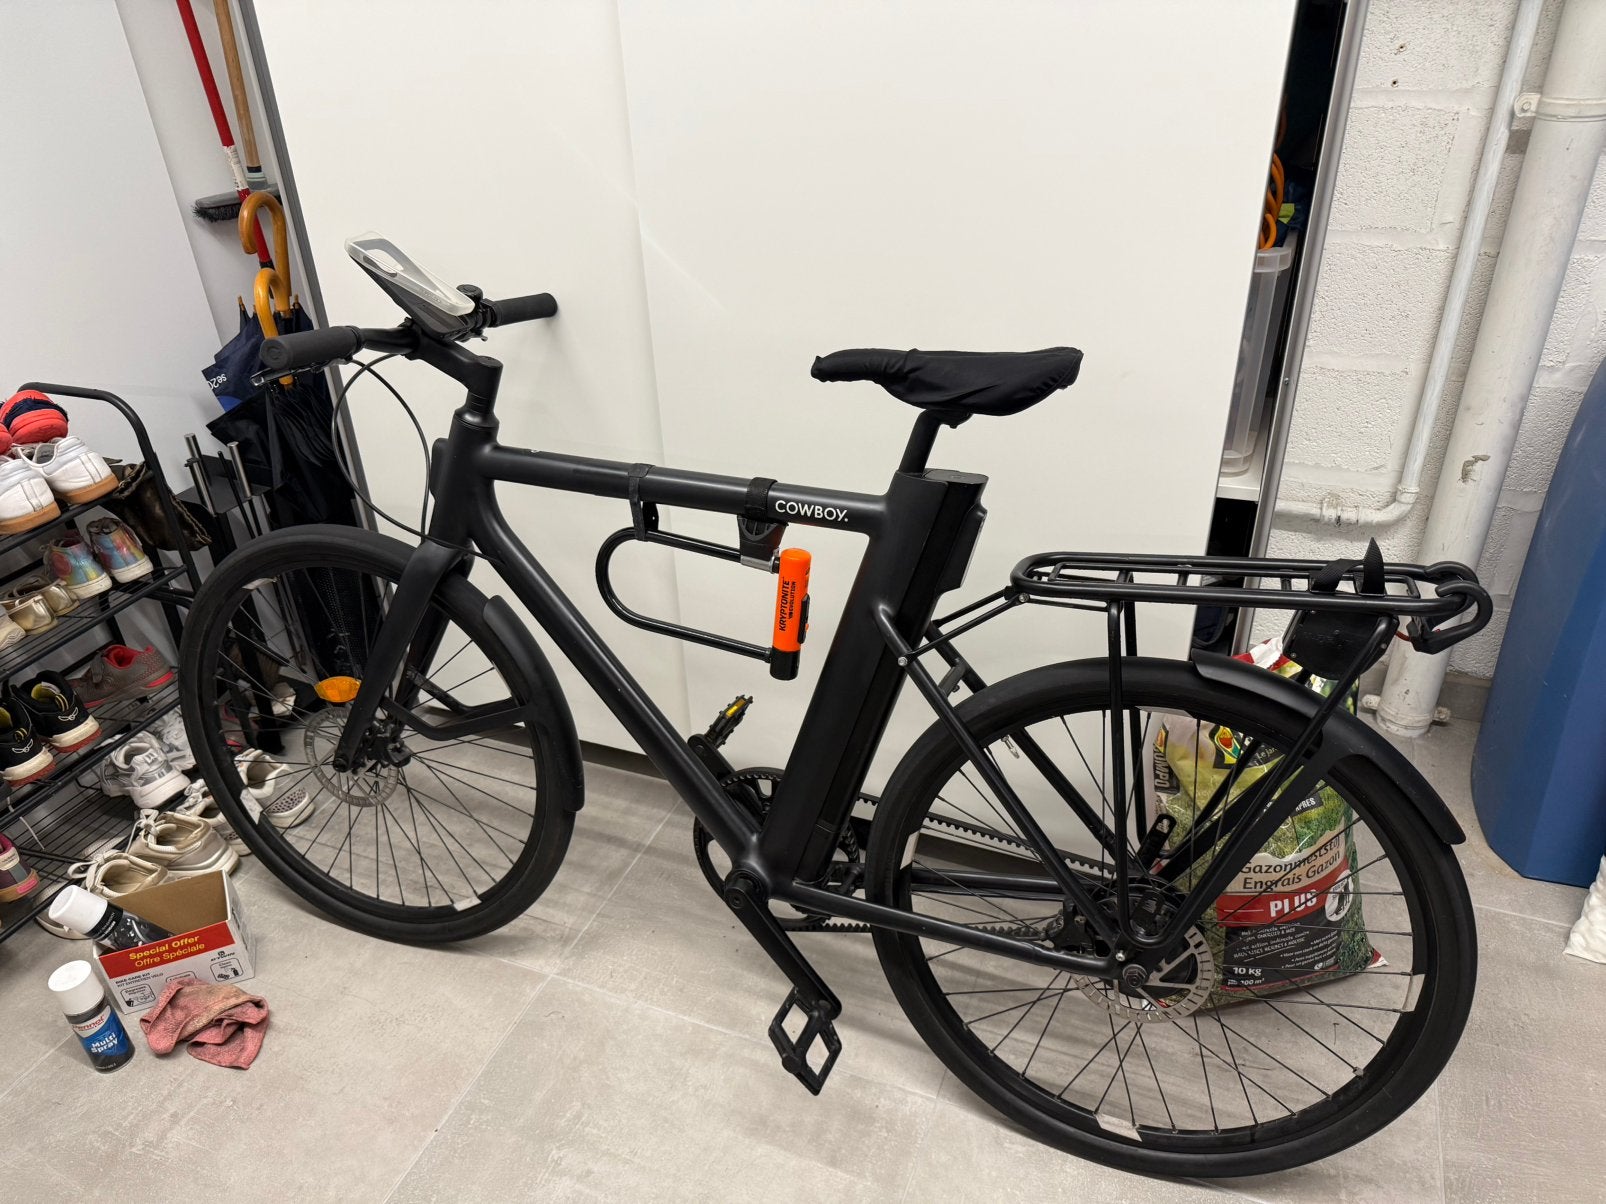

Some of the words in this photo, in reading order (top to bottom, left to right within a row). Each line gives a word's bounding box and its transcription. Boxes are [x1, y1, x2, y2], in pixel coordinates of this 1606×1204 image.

[778, 579, 791, 632] KRYPTONITE
[1242, 874, 1302, 893] Engrais
[1306, 850, 1341, 879] Gazon
[1269, 889, 1318, 918] PLUS
[129, 944, 169, 960] Special
[172, 935, 200, 948] Offer
[135, 957, 161, 968] Offre
[162, 943, 205, 960] Spéciale
[1248, 968, 1262, 977] kg
[91, 1038, 118, 1053] Spray
[92, 1032, 116, 1048] Multi
